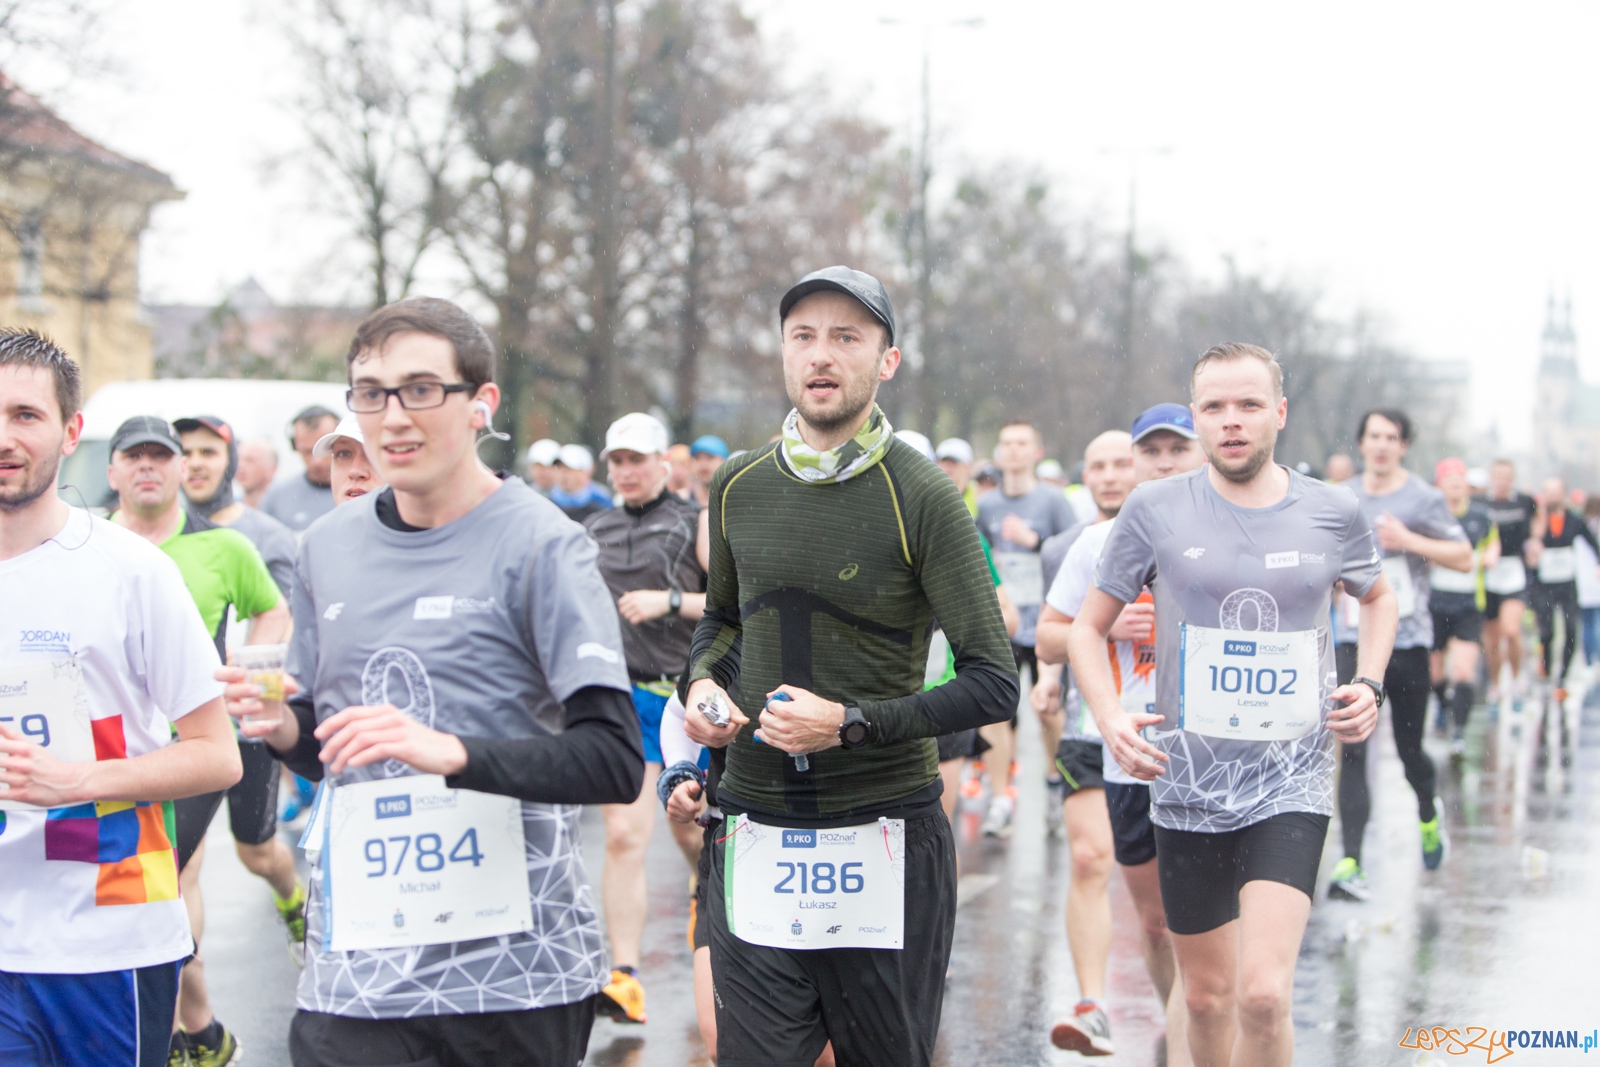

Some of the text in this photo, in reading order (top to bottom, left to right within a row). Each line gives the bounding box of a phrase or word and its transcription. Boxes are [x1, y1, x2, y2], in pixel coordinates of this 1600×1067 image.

[1183, 546, 1206, 560] 4F
[20, 629, 71, 642] JORDAN
[1208, 664, 1298, 695] 10102
[1237, 697, 1271, 708] Leszek
[0, 713, 51, 747] 9
[1259, 721, 1274, 729] 4F
[364, 826, 484, 878] 9784
[773, 861, 865, 894] 2186
[798, 899, 838, 909] Łukasz
[826, 924, 842, 934] 4F
